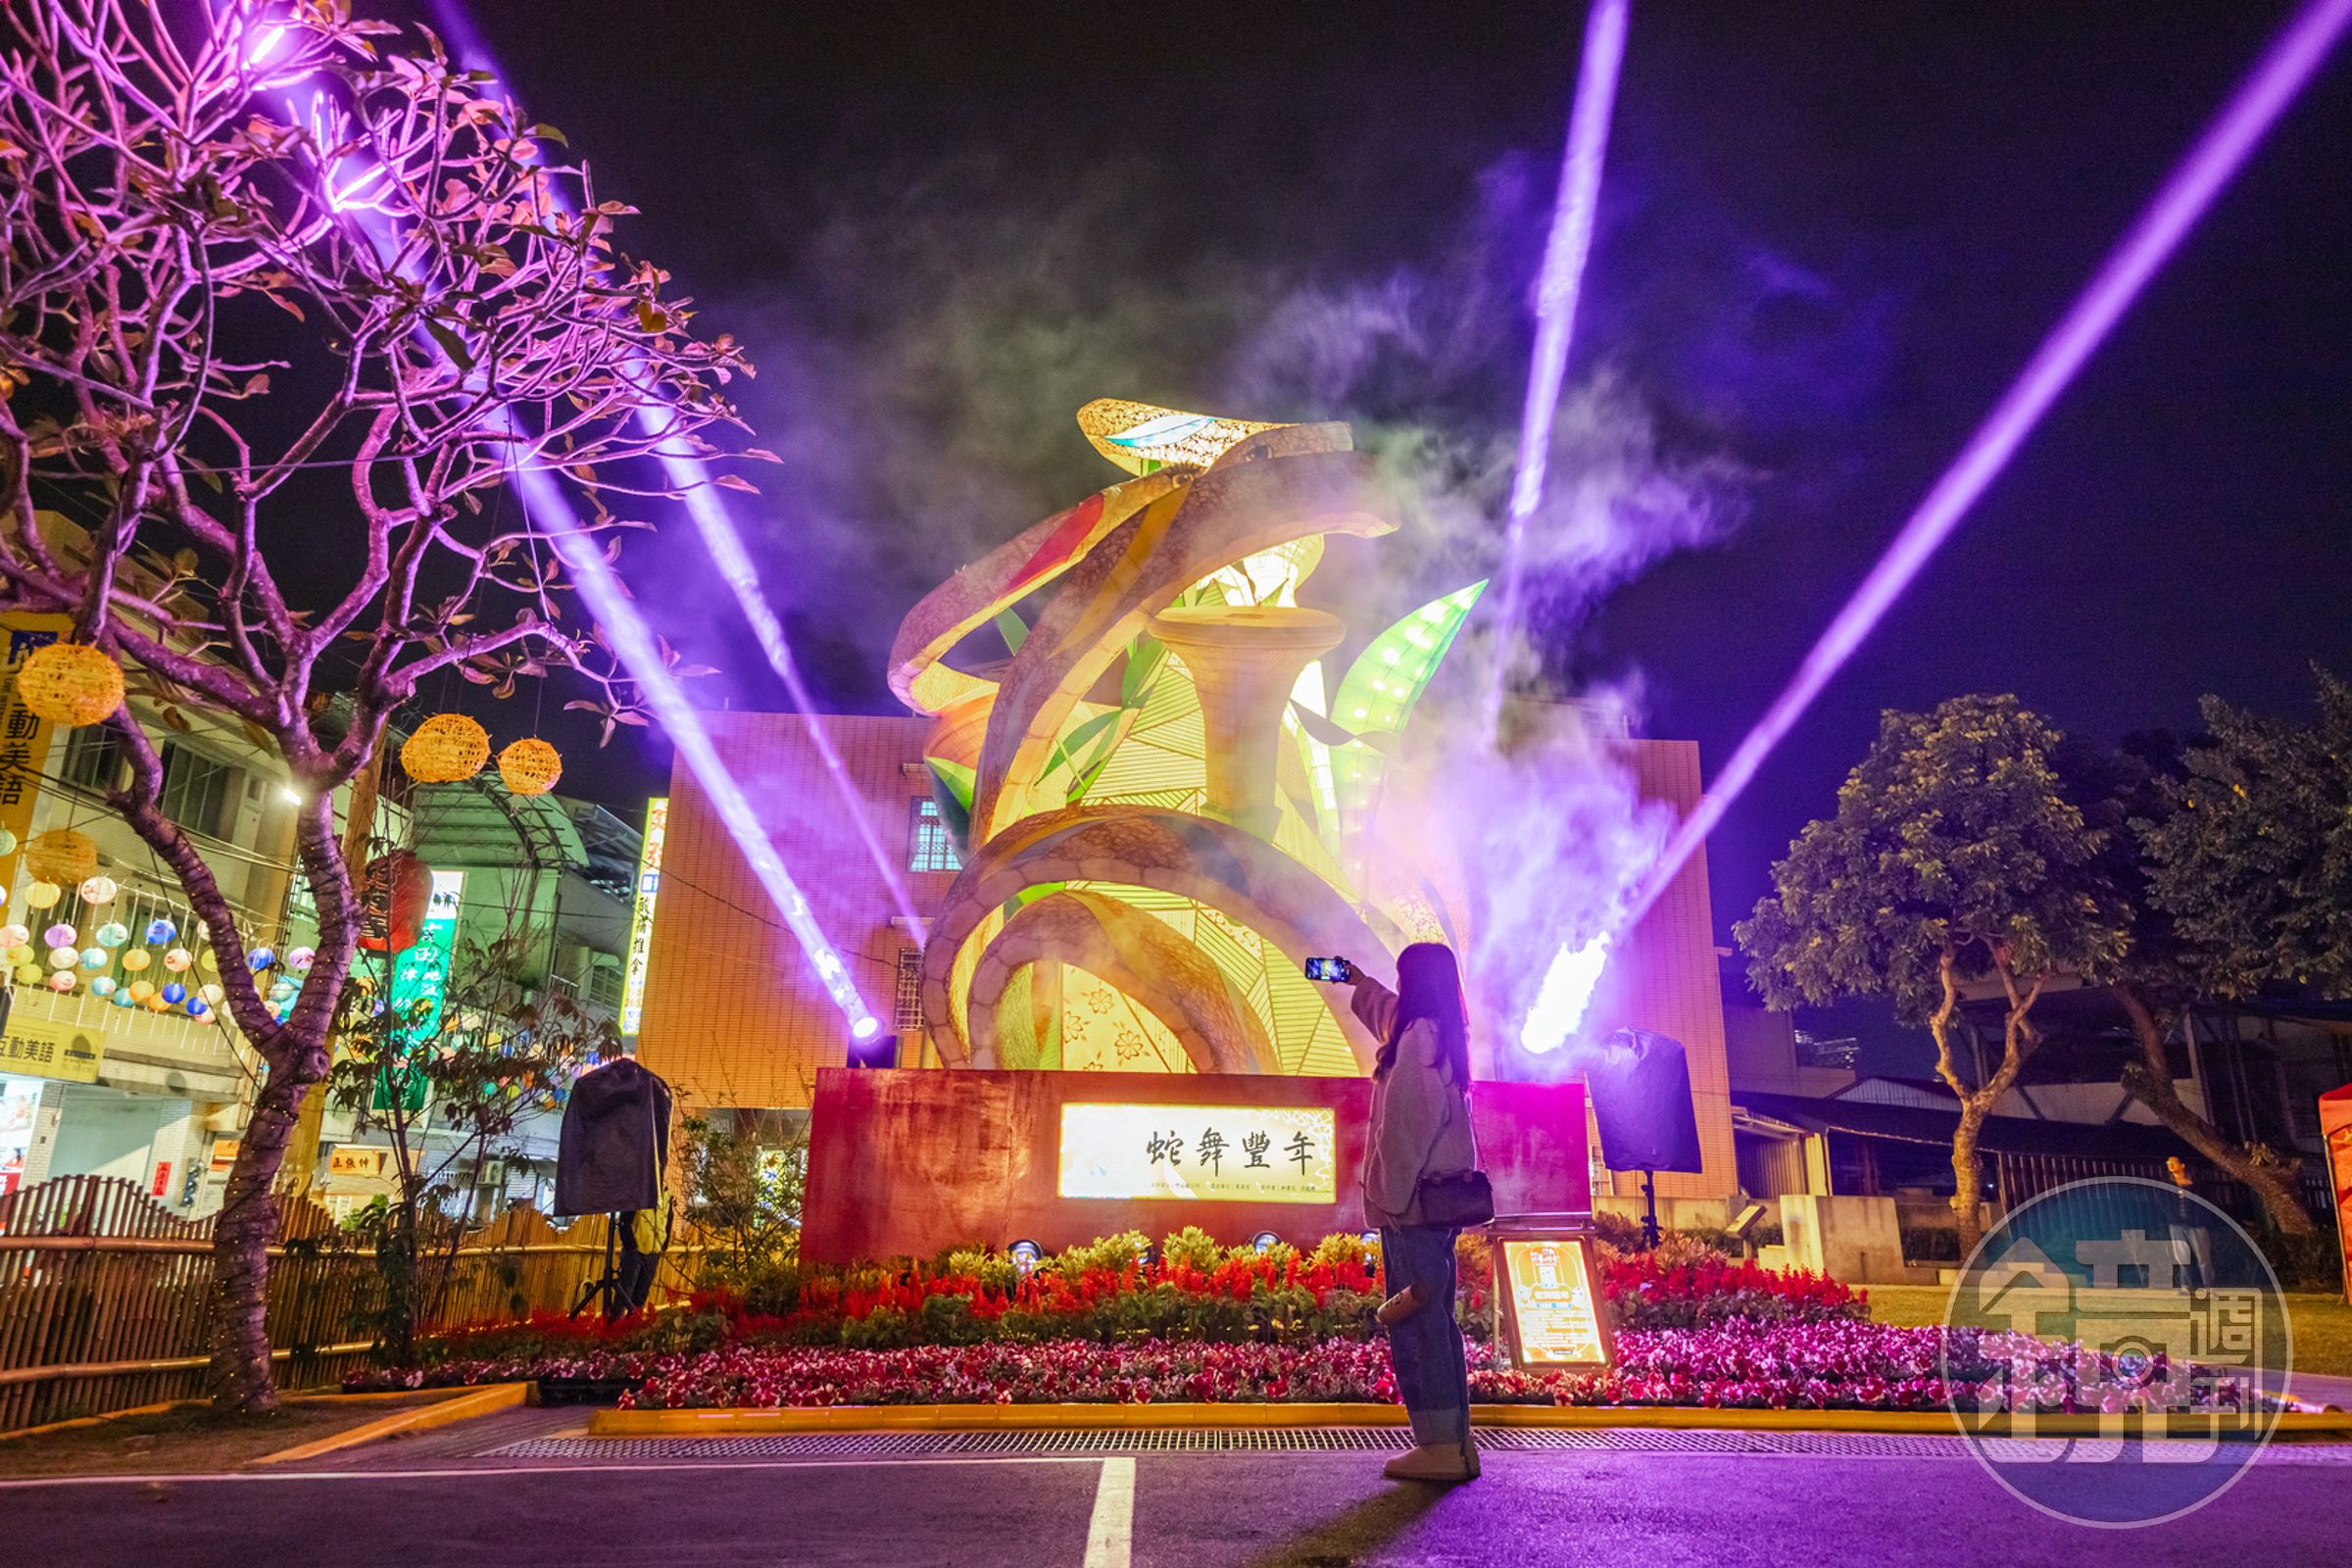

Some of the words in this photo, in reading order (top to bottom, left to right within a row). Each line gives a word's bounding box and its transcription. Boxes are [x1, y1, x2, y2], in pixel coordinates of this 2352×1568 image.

[0, 693, 40, 806] 動美語
[1145, 1126, 1316, 1177] 蛇舞豐年
